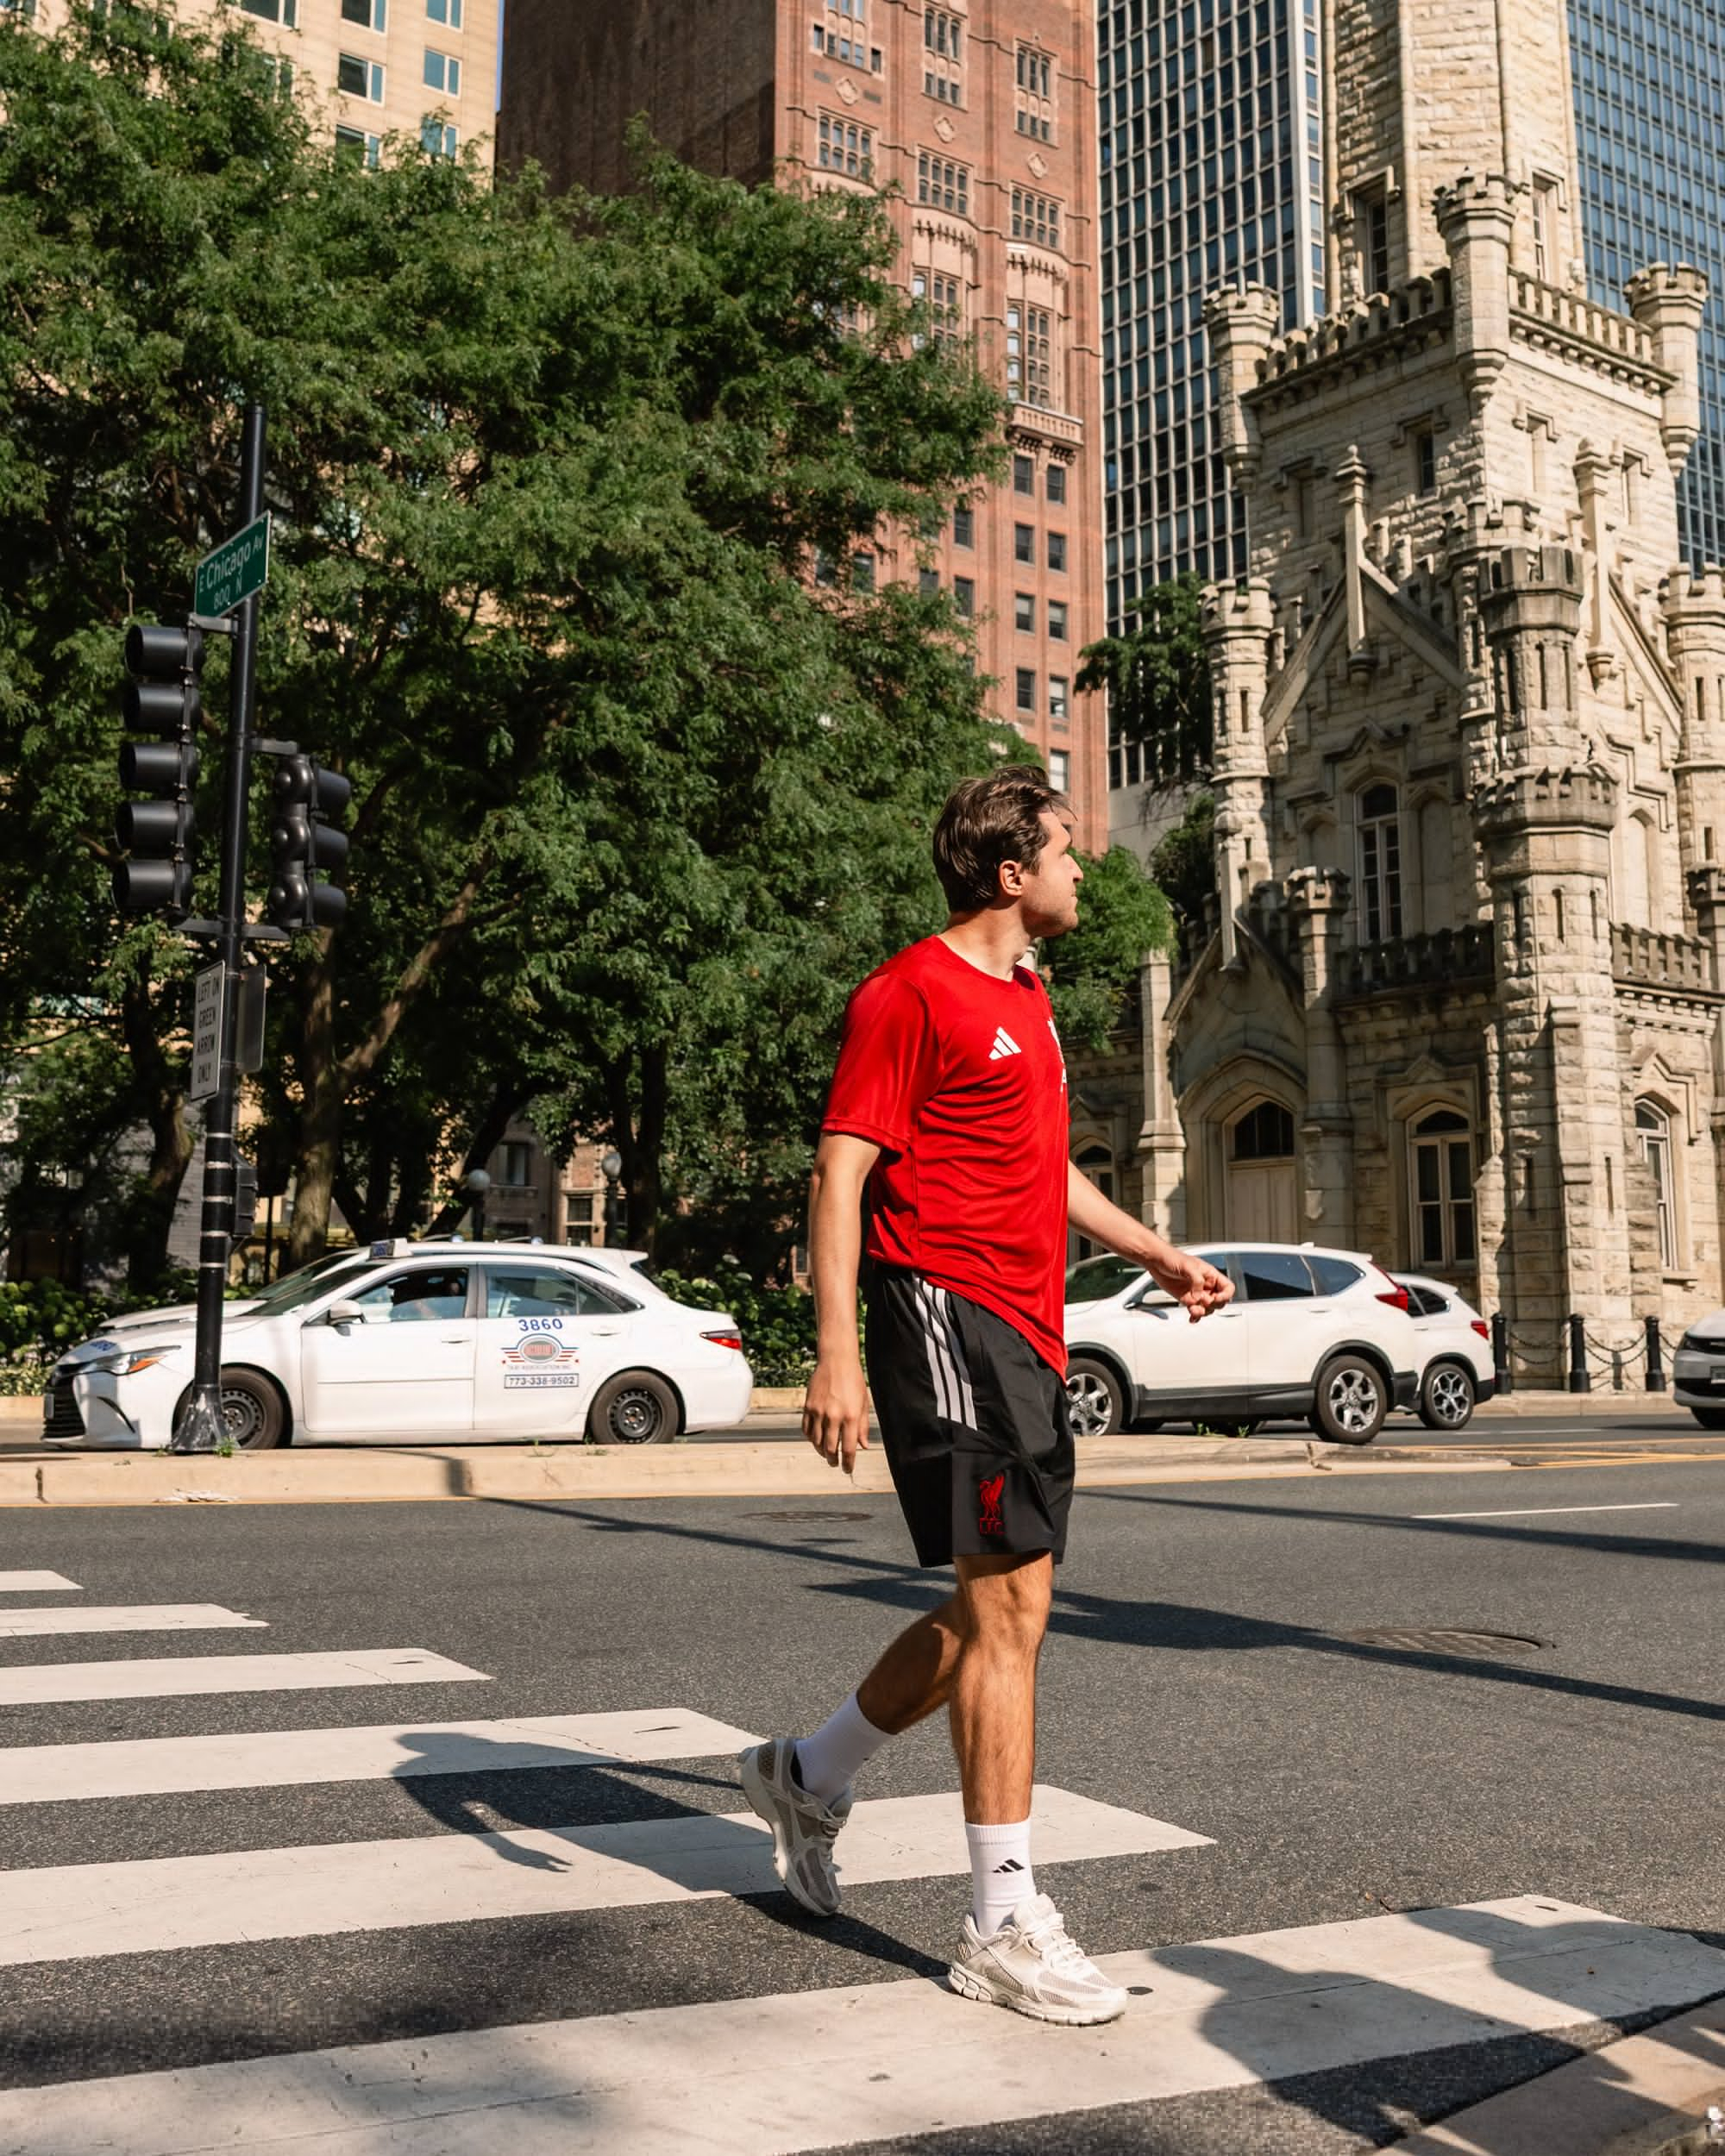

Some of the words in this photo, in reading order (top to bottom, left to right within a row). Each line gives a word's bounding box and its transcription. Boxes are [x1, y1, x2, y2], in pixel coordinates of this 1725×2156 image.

[199, 574, 205, 593] E
[207, 541, 251, 589] Chicago
[214, 585, 230, 611] 800
[235, 575, 242, 594] N
[198, 980, 210, 1003] LEFT
[212, 976, 220, 996] ON
[199, 1006, 216, 1028] GREEN
[197, 1034, 215, 1056] ARROW
[198, 1062, 212, 1084] ONLY
[518, 1318, 563, 1332] 3860
[508, 1376, 575, 1386] 773-338-9502
